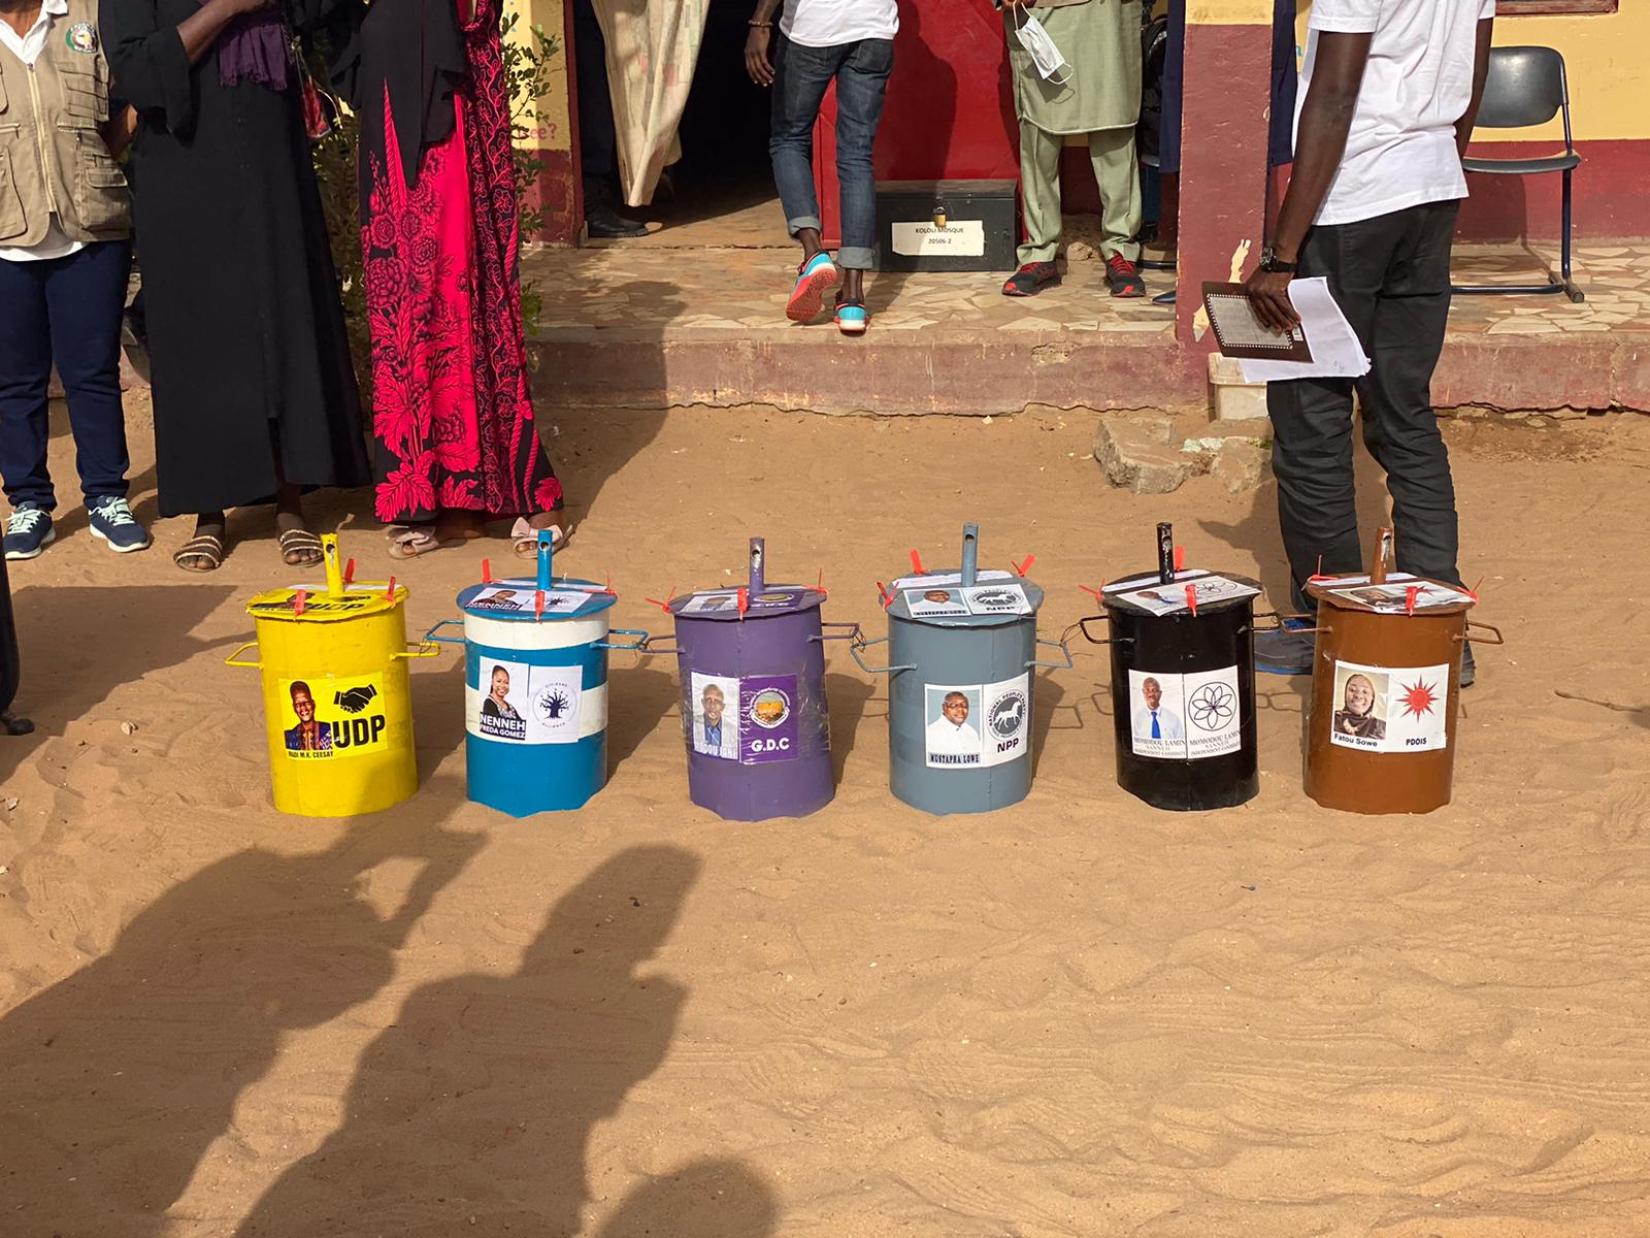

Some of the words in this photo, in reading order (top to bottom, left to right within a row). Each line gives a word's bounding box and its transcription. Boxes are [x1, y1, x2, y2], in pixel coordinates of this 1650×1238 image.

[480, 713, 526, 732] NENNEH
[332, 714, 386, 749] UDP
[997, 737, 1019, 753] NPP
[1334, 733, 1354, 744] Fatou
[1356, 737, 1378, 748] Sowe
[1405, 737, 1427, 747] PDOIS
